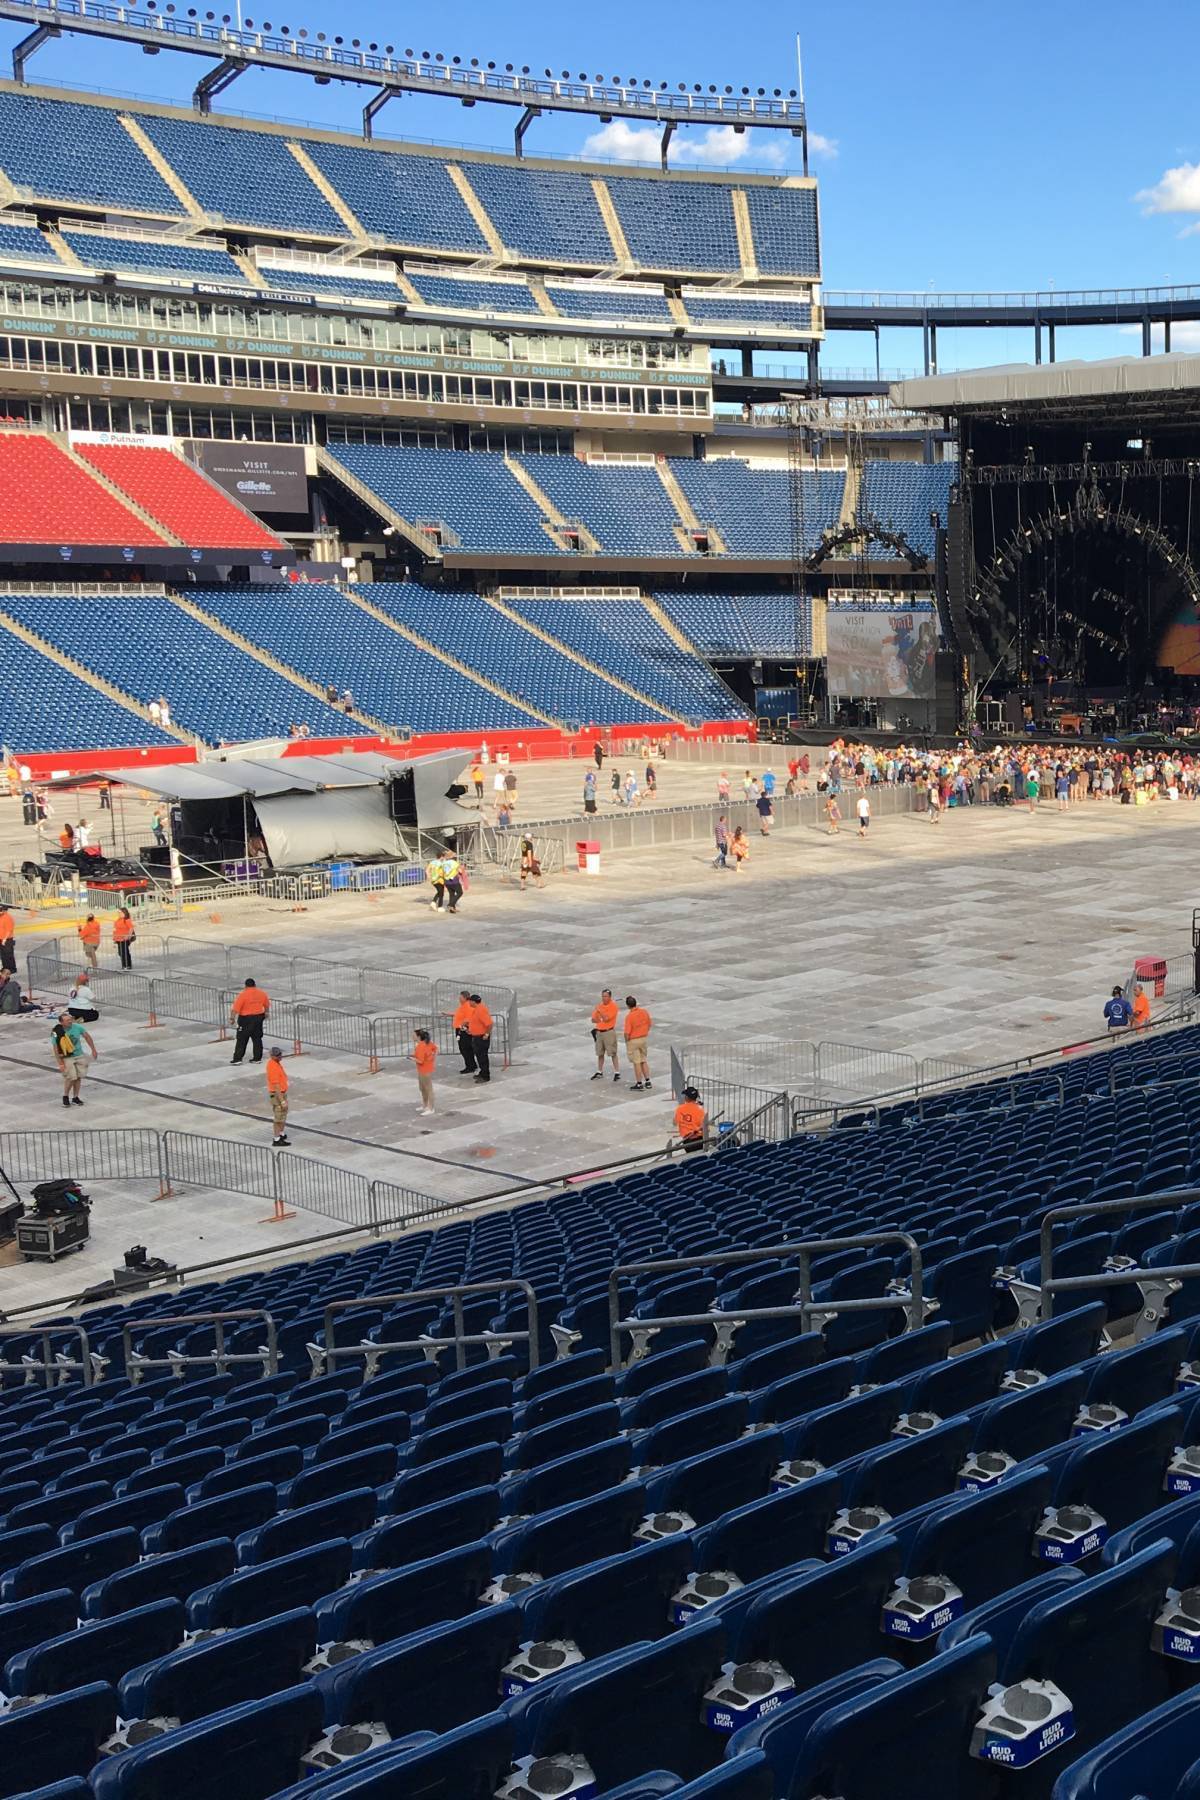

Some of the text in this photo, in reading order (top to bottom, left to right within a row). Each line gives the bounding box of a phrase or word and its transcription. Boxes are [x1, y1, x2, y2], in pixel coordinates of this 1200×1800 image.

[198, 284, 218, 294] DELL
[4, 319, 708, 386] DUNKIN' DUNKIN' DUNKIN' DUNKIN' DUNKIN' DUNKIN' DUNKIN' DUNKIN' DUNKIN' DUNKIN'
[111, 434, 144, 444] Putnam
[243, 460, 268, 469] VISIT
[236, 480, 272, 490] Gillette
[1174, 1484, 1192, 1492] LIGHT
[1176, 1480, 1190, 1488] BUD
[1084, 1534, 1098, 1546] BUD
[1048, 1546, 1062, 1554] BUD
[1082, 1538, 1100, 1554] LIGHT
[1045, 1550, 1064, 1558] LIGHT
[934, 1608, 950, 1620] BUD
[894, 1618, 908, 1626] BUD
[931, 1612, 953, 1630] LIGHT
[892, 1624, 911, 1632] LIGHT
[1174, 1636, 1190, 1646] BUD
[1171, 1642, 1194, 1653] LIGHT
[760, 1696, 778, 1712] BUD
[716, 1712, 730, 1721] BUD
[714, 1718, 734, 1728] LIGHT
[1042, 1721, 1061, 1740] BUD
[1040, 1727, 1065, 1750] LIGHT
[991, 1746, 1011, 1755] BUD
[988, 1752, 1016, 1762] LIGHT
